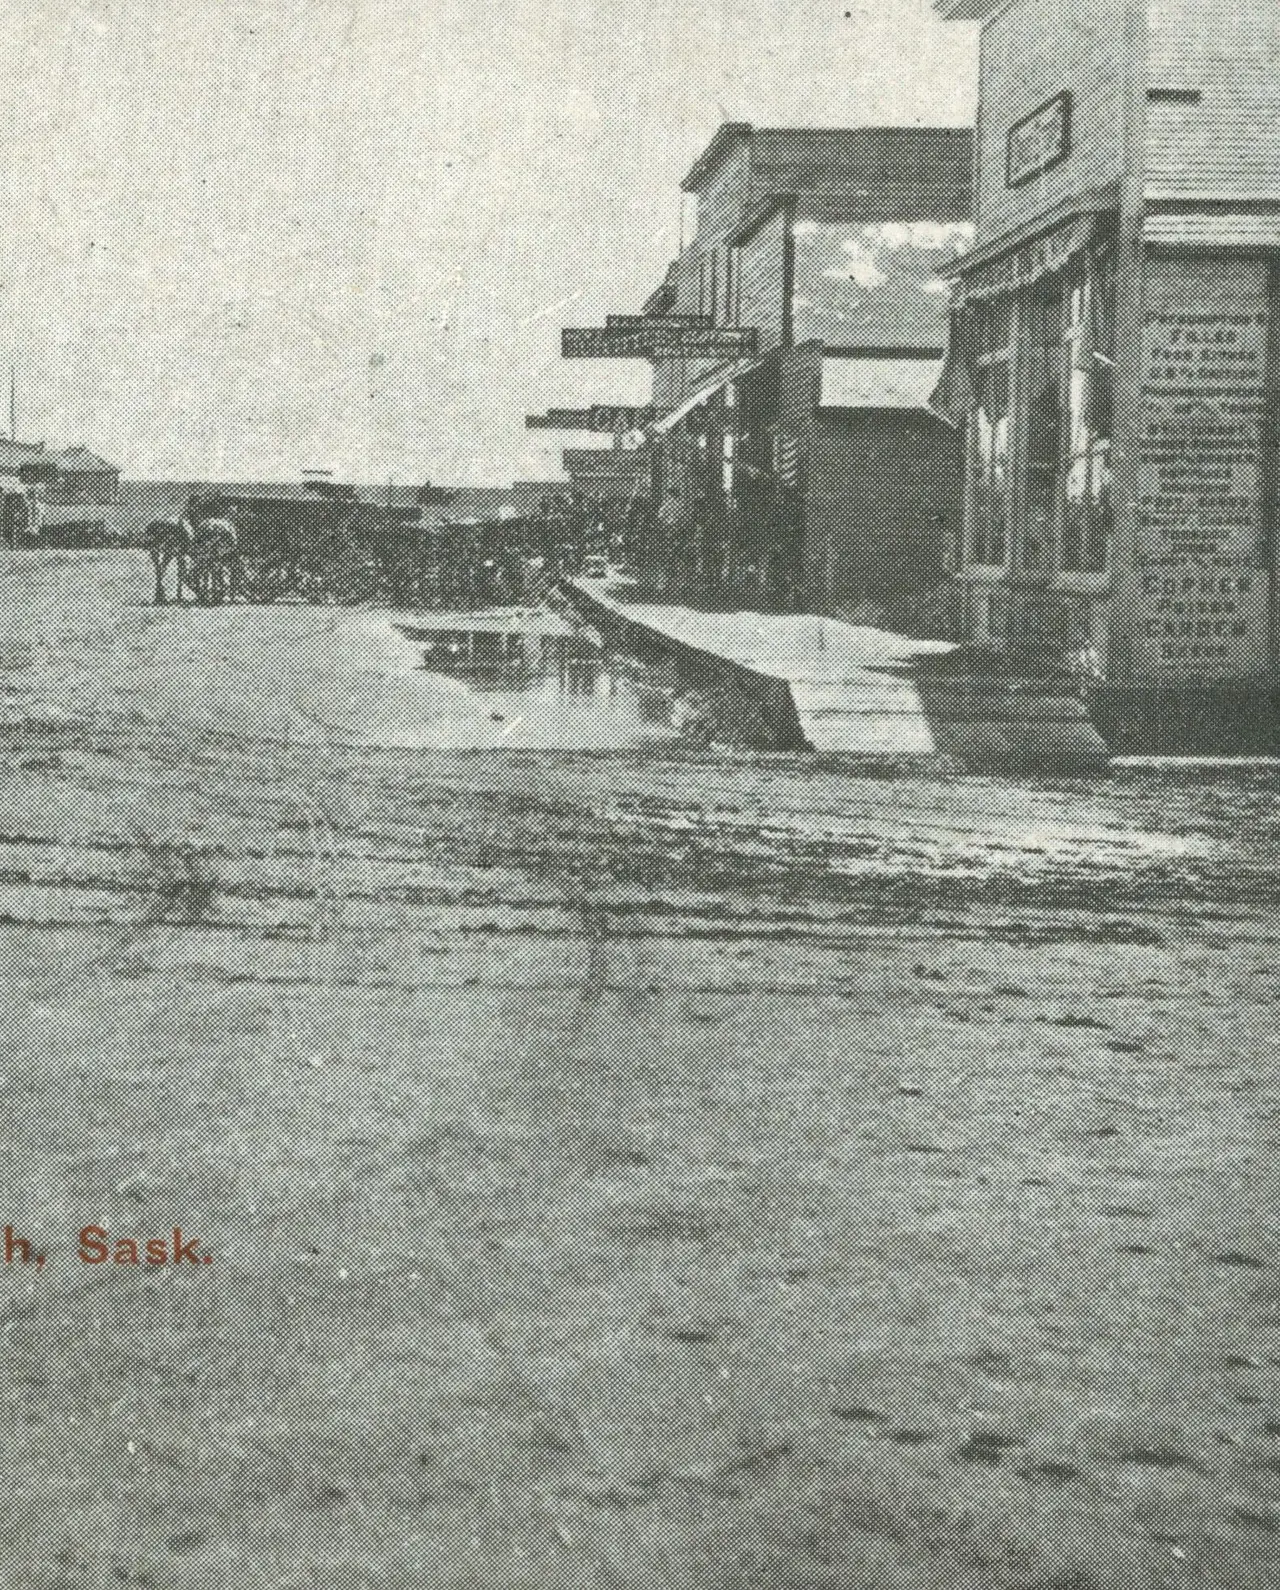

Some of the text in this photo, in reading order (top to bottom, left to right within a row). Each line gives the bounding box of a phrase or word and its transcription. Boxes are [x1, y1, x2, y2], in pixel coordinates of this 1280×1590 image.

[1169, 329, 1236, 344] FILLED
[1143, 576, 1251, 594] GOPHER
[1157, 600, 1235, 614] POISON
[1144, 620, 1246, 638] GARDEN
[1161, 643, 1228, 659] SEEDS
